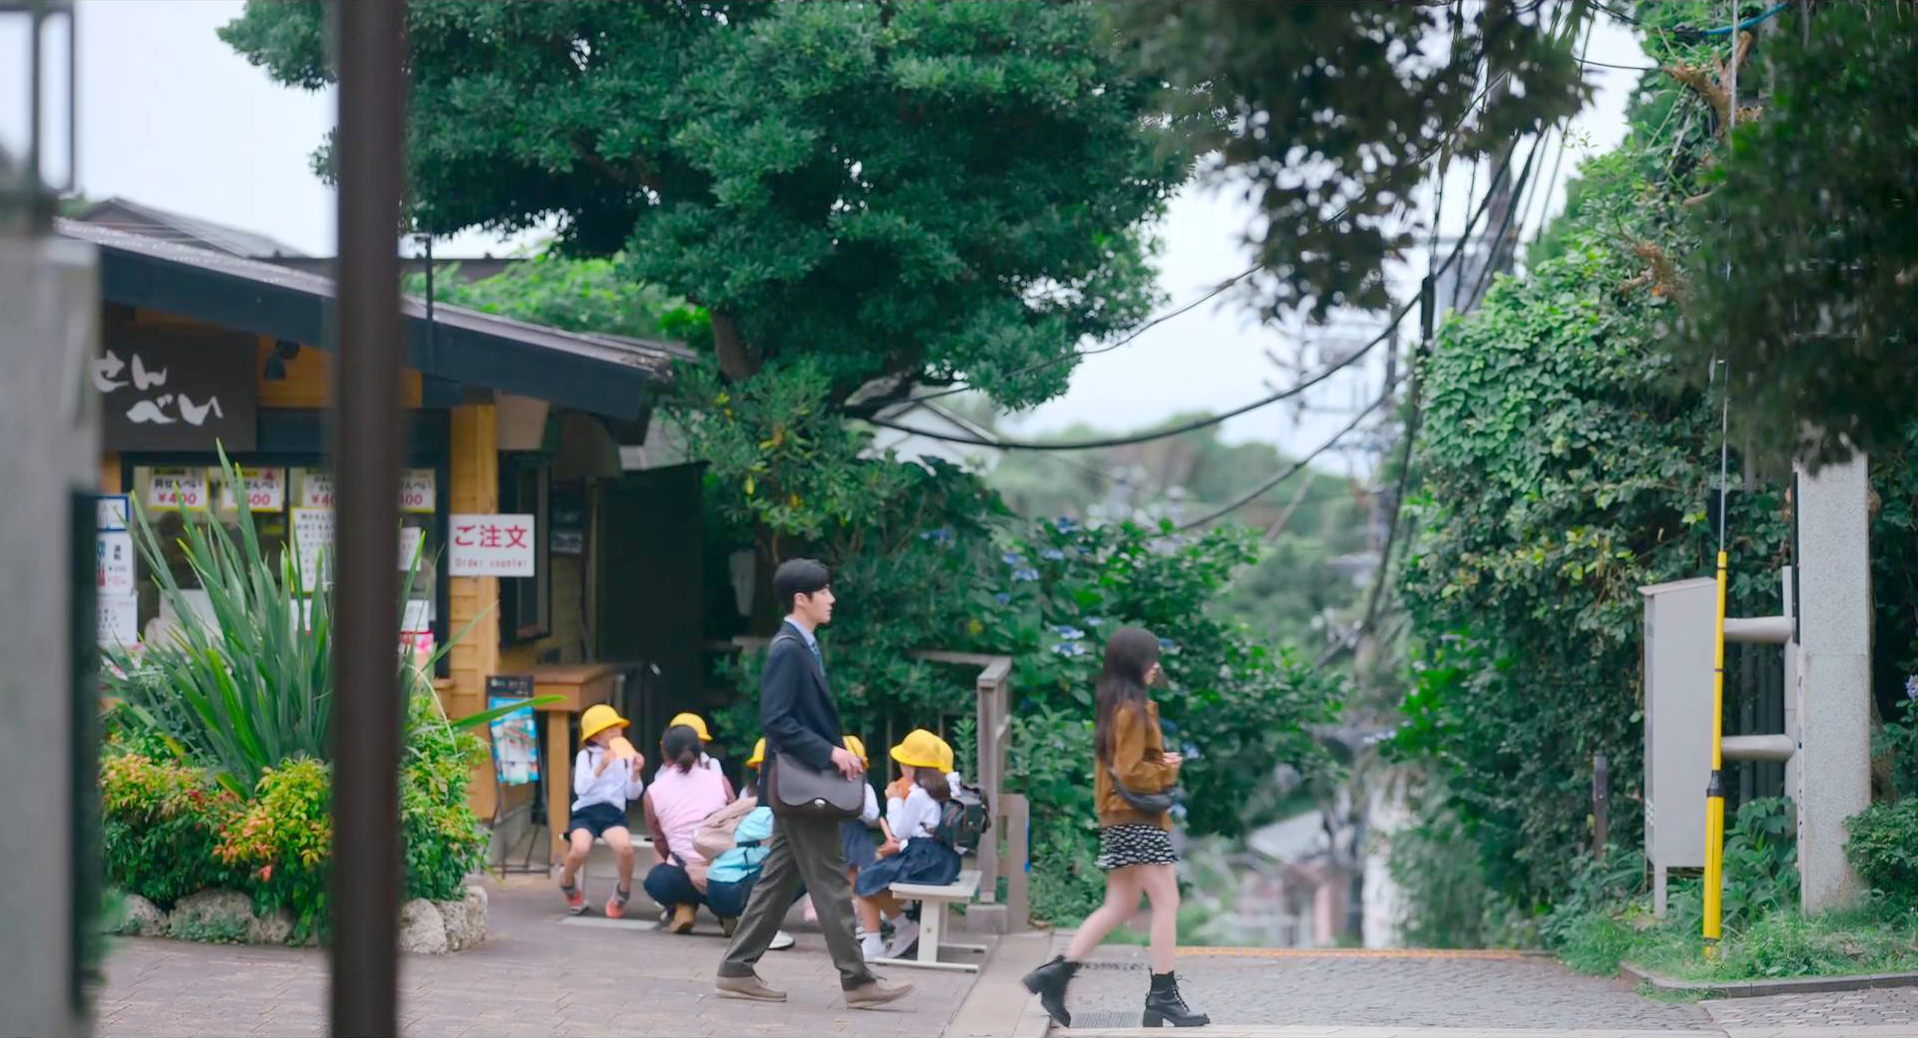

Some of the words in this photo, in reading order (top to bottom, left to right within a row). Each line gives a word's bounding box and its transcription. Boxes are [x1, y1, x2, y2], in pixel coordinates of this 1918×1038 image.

[126, 394, 223, 426] べい
[455, 524, 527, 548] ご注文
[455, 558, 483, 568] Order
[490, 558, 528, 568] counter
